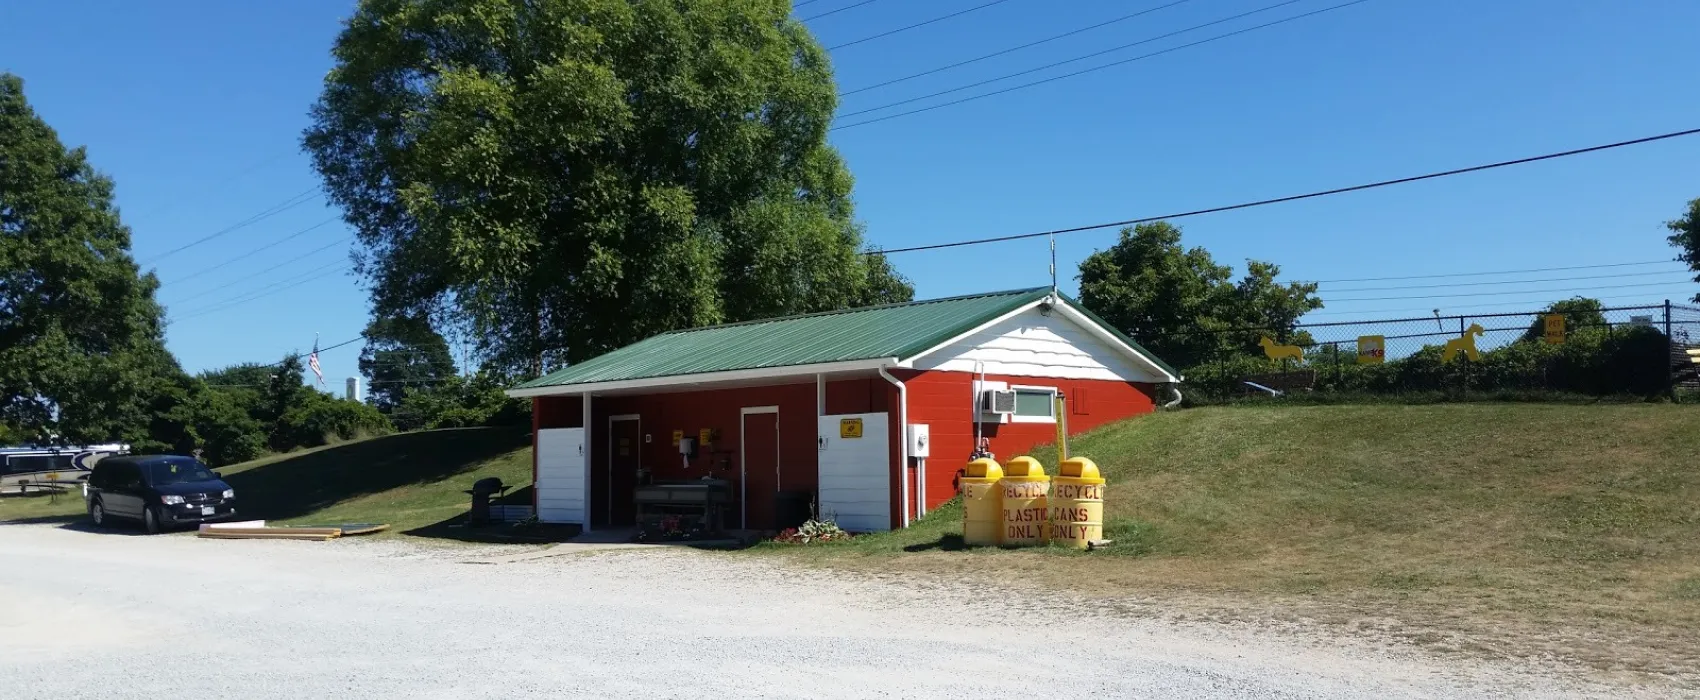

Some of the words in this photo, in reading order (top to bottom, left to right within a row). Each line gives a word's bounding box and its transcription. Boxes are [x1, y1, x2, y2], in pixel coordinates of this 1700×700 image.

[1548, 319, 1561, 328] PET
[1003, 507, 1048, 522] PLASTIC
[1054, 507, 1088, 522] CANS
[1008, 524, 1043, 539] ONLY
[1054, 524, 1088, 539] ONLY
